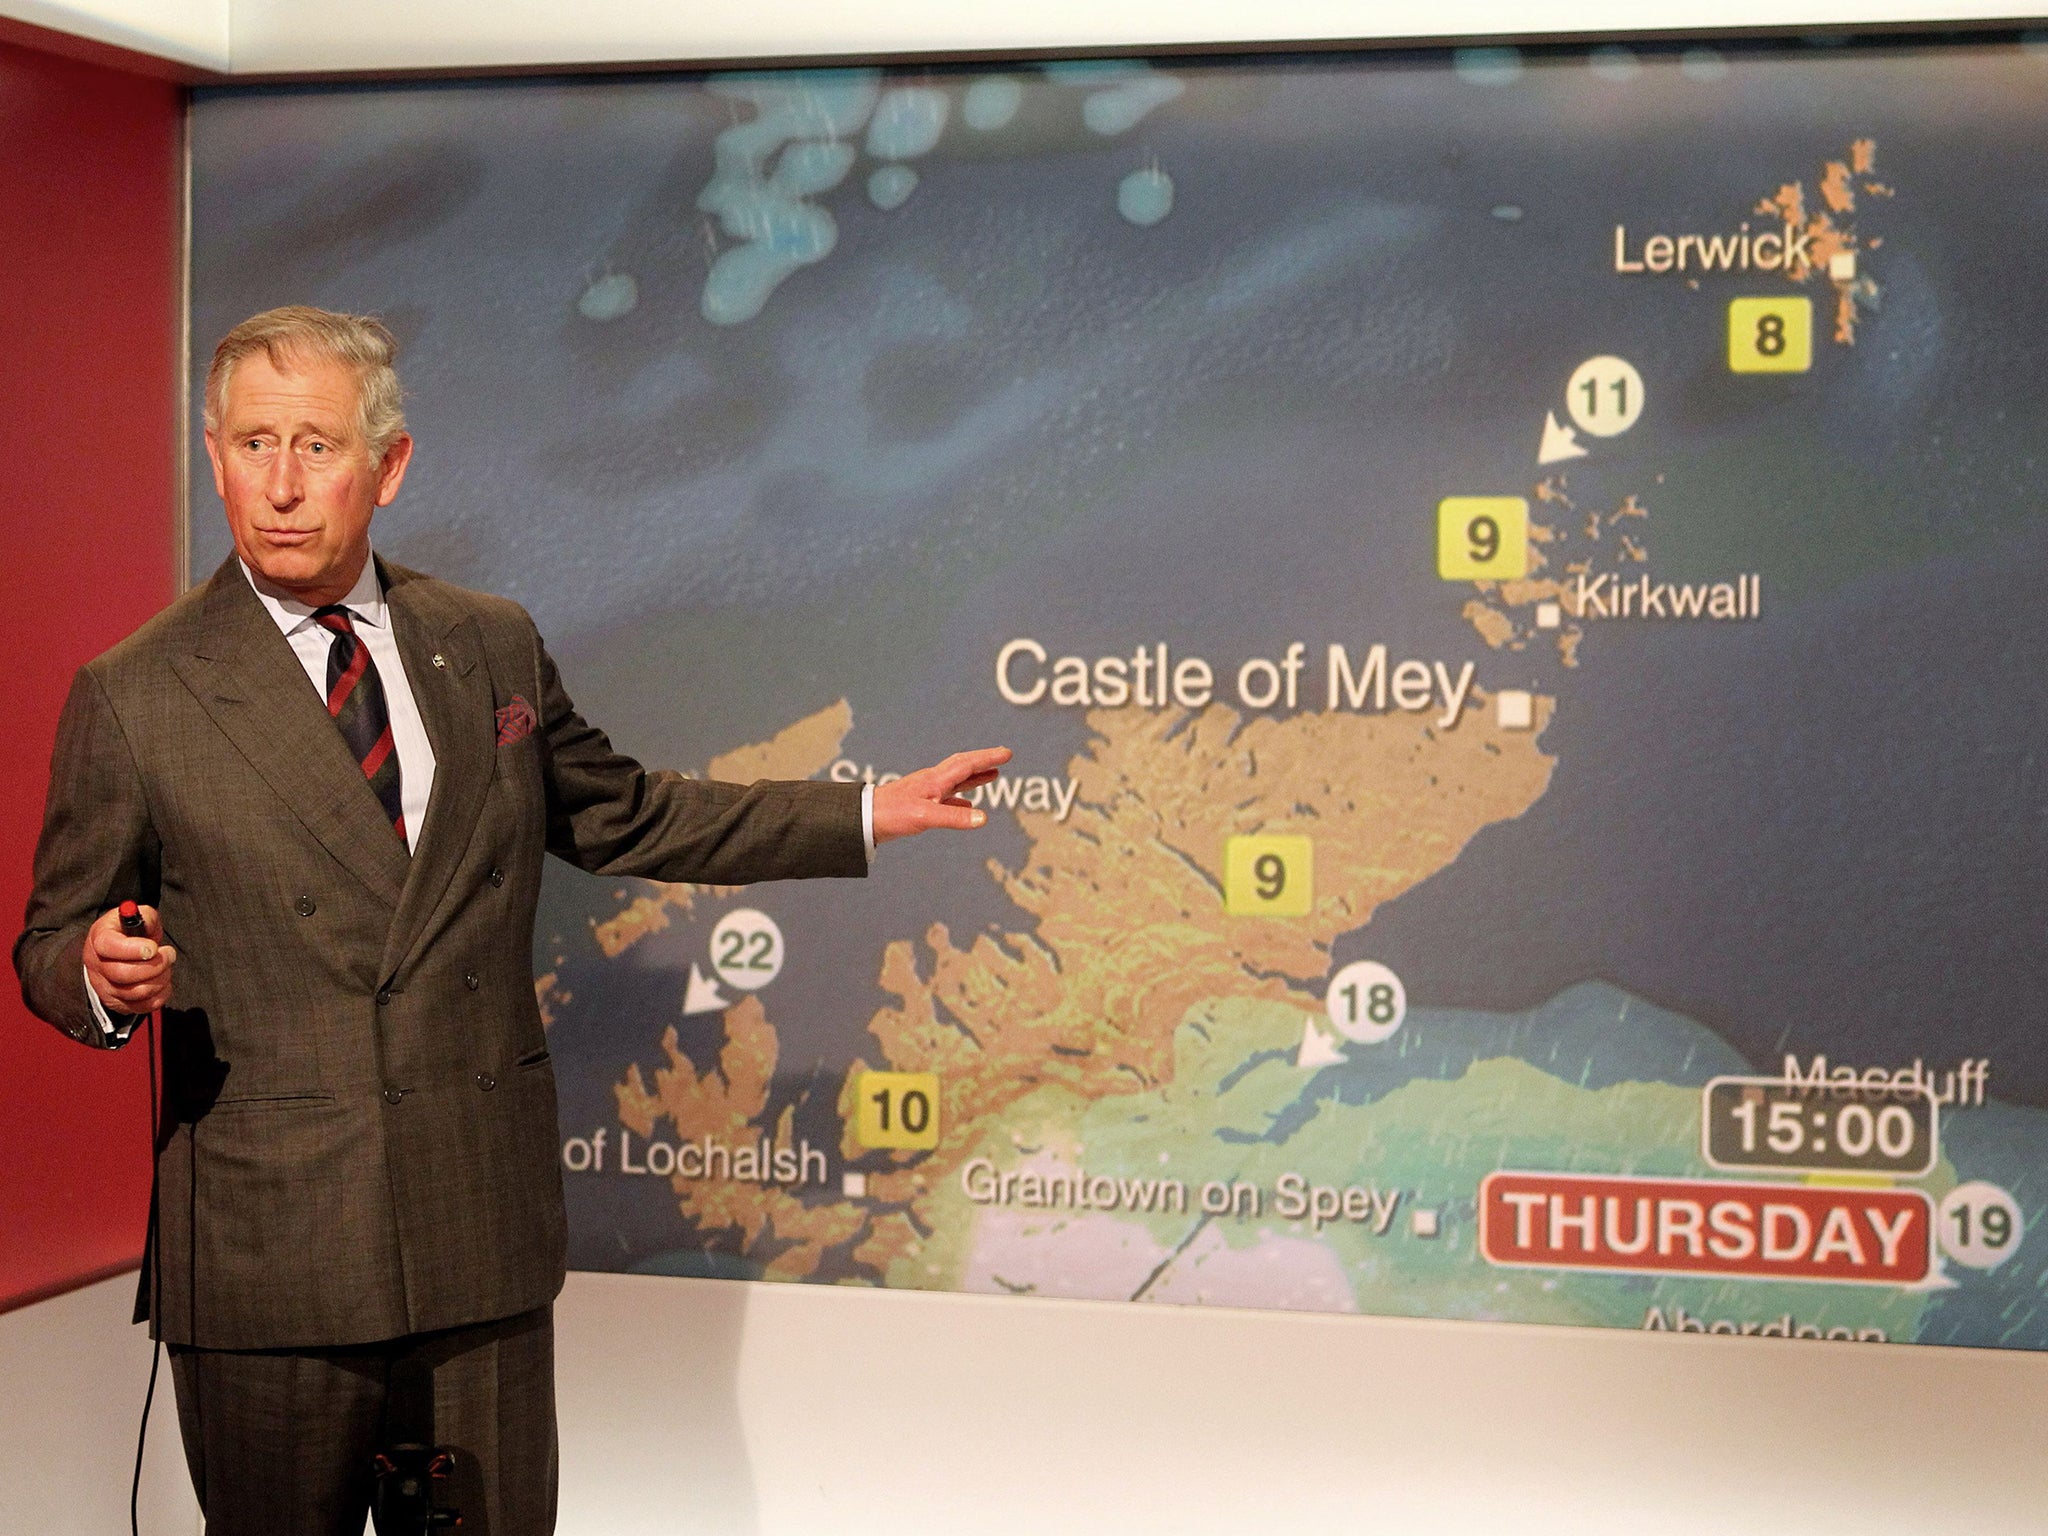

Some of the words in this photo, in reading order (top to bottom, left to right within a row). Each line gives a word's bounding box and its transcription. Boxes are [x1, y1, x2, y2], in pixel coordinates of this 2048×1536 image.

[1615, 223, 1813, 273] Lerwick
[1755, 315, 1786, 357] 8
[1580, 377, 1629, 417] 11
[1466, 516, 1501, 562] 9
[1575, 574, 1761, 620] Kirkwall
[996, 638, 1214, 707] Castle
[1237, 642, 1306, 710] of
[1327, 643, 1475, 728] Mey
[1254, 854, 1286, 901] 9
[718, 931, 775, 970] 22
[1339, 983, 1396, 1025] 18
[1784, 1054, 1990, 1105] Macduff
[872, 1089, 930, 1134] 10
[1731, 1100, 1916, 1159] 15:00
[563, 1129, 606, 1172] of
[621, 1131, 828, 1184] Lochalsh
[961, 1157, 1187, 1213] Grantown
[1201, 1180, 1261, 1216] on
[1276, 1172, 1401, 1236] Spey
[1502, 1191, 1915, 1268] THURSDAY
[1948, 1201, 2013, 1250] 19
